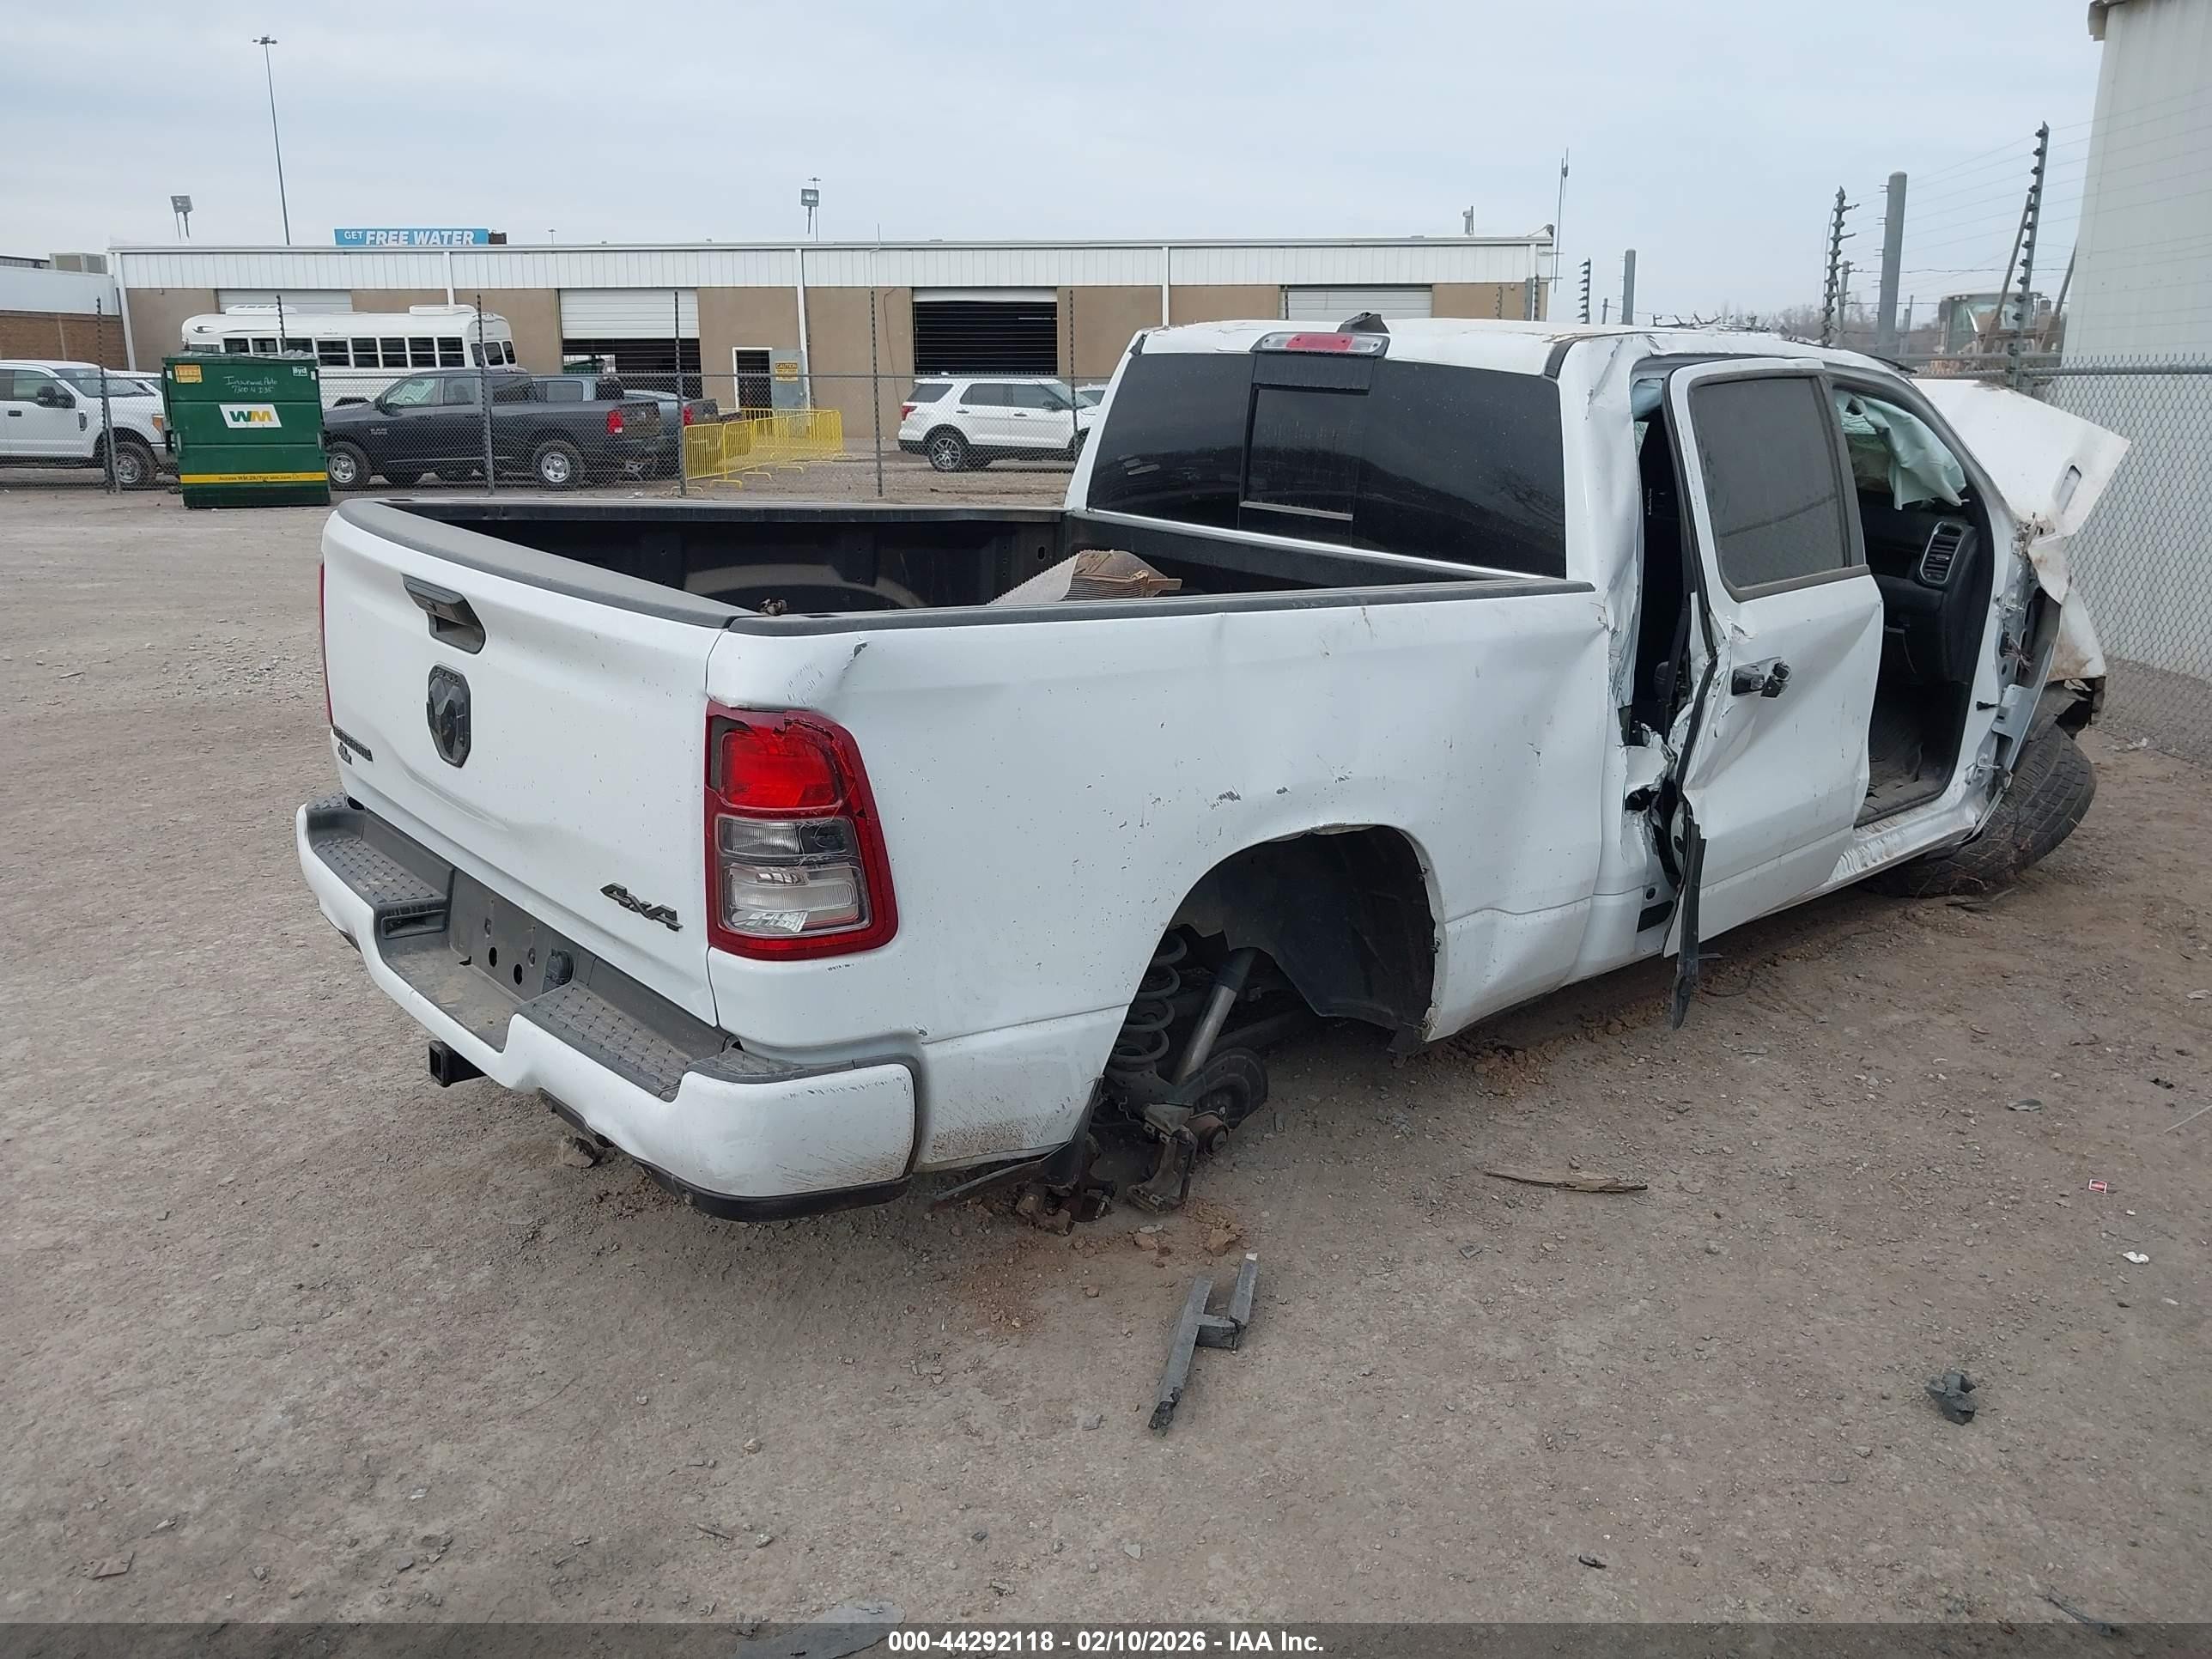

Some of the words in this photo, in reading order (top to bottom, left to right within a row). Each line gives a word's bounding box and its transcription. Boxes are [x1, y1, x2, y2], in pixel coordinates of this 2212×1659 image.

[343, 231, 363, 240] GET
[366, 230, 409, 245] FREE
[413, 230, 475, 245] WATER
[228, 410, 274, 422] WM
